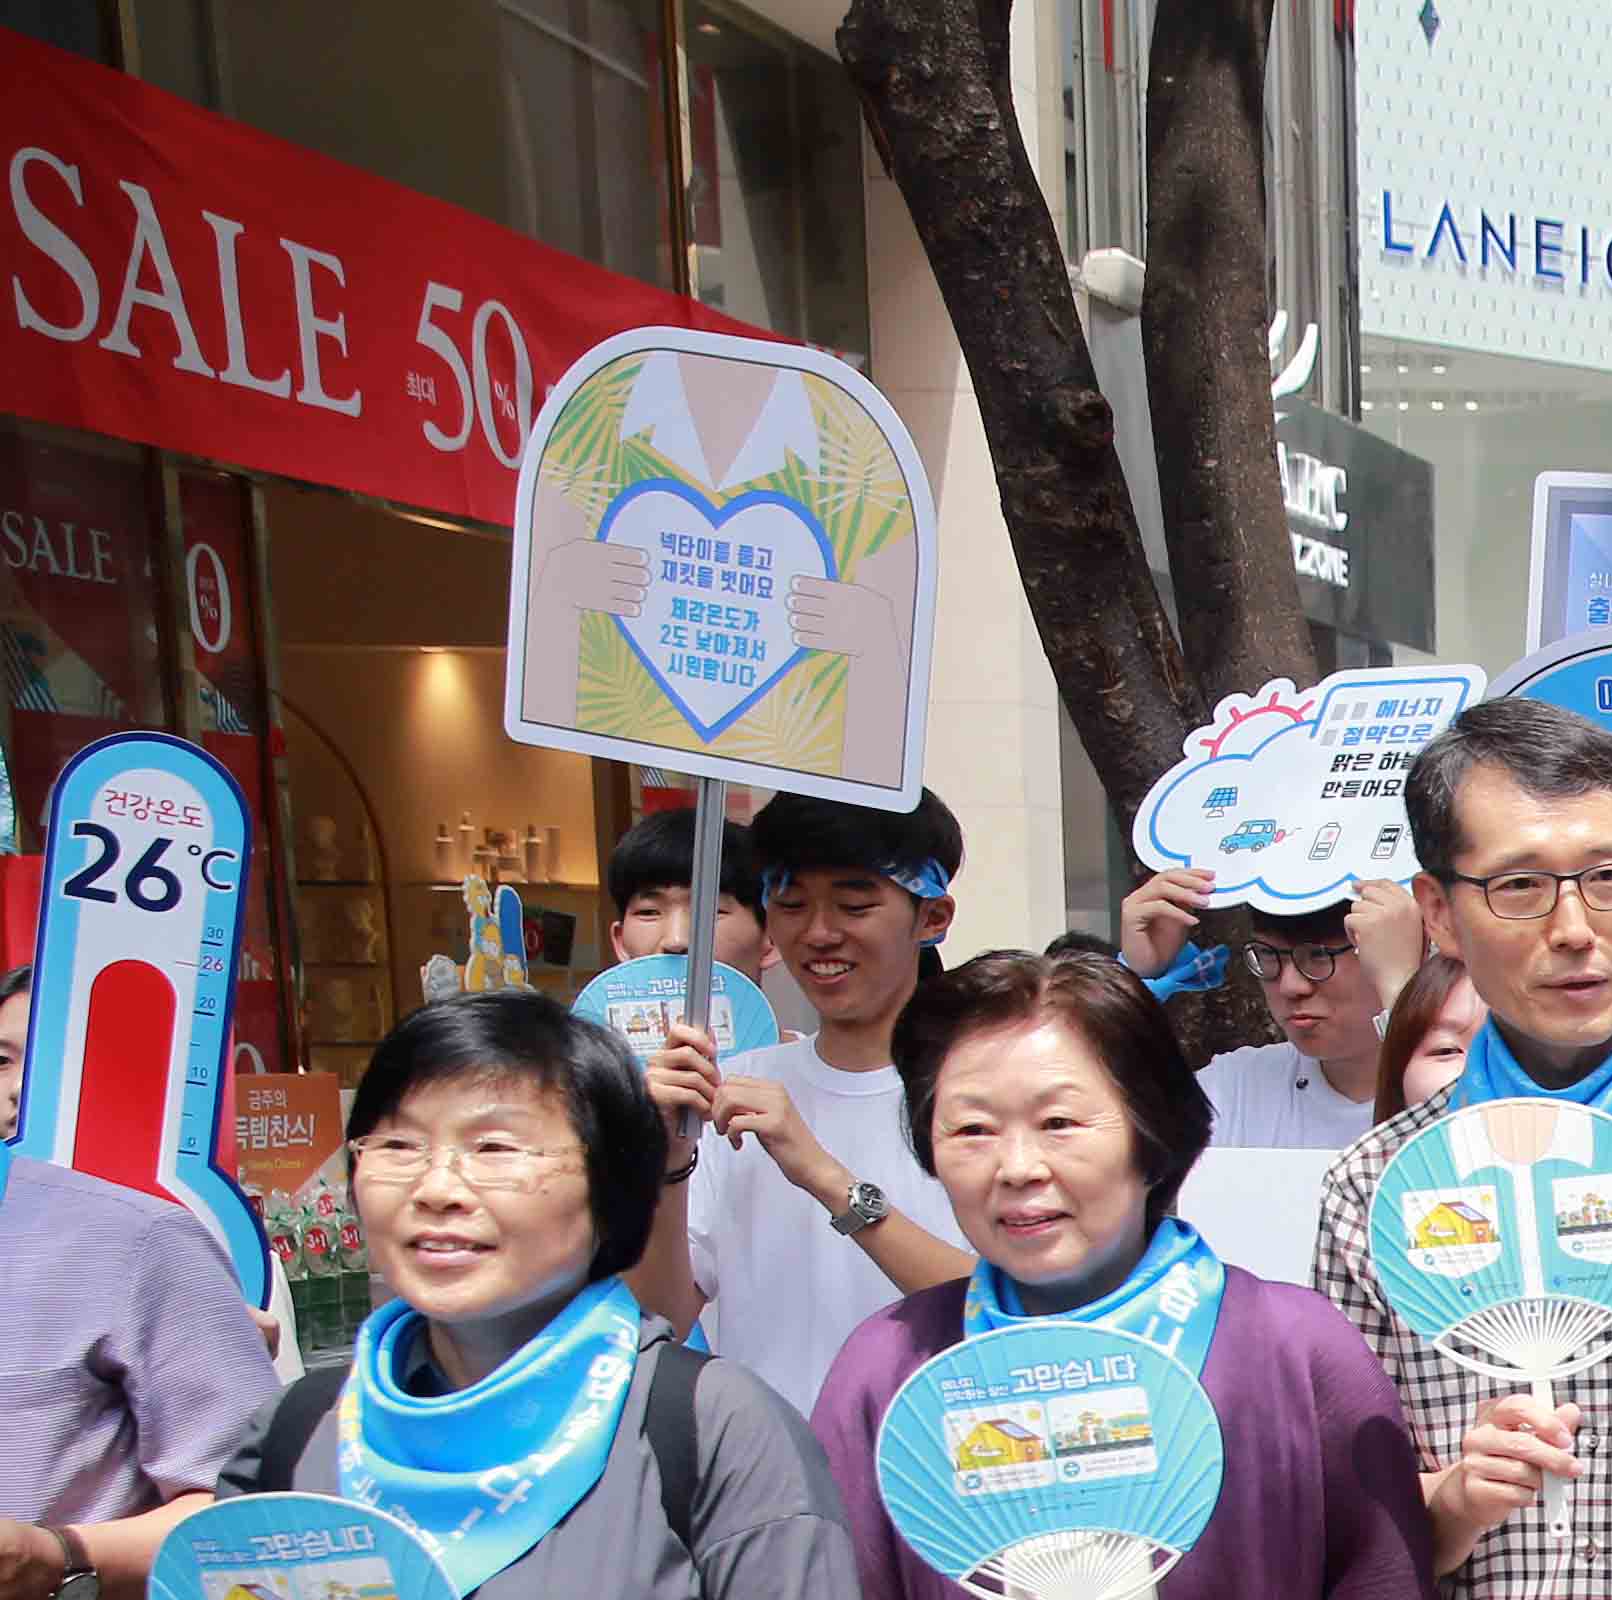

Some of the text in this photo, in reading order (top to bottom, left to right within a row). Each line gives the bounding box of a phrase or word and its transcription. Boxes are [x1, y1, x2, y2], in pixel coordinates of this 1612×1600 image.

[10, 146, 362, 417] SALE
[406, 373, 436, 406] 최대
[415, 280, 534, 470] 50
[1, 511, 117, 584] SALE
[659, 531, 773, 571] 넥타이를 풀고
[661, 559, 773, 599] 재킷을 벗어요
[672, 597, 760, 632] 체감온도가
[659, 624, 766, 661] 2도 낮아져서
[668, 652, 757, 688] 시원합니다
[1375, 697, 1444, 719] 에너지
[1342, 723, 1434, 746] 절약으로
[1330, 751, 1374, 773] 맑은
[104, 788, 204, 829] 건강온도
[207, 927, 224, 940] 30
[202, 956, 224, 972] 26
[200, 997, 216, 1011] 20
[191, 1066, 208, 1080] 10
[247, 1089, 288, 1111] 금주의
[306, 1231, 330, 1249] 3+1
[1009, 1353, 1137, 1394] 고맙습니다
[249, 1524, 376, 1562] 고맙습니다
